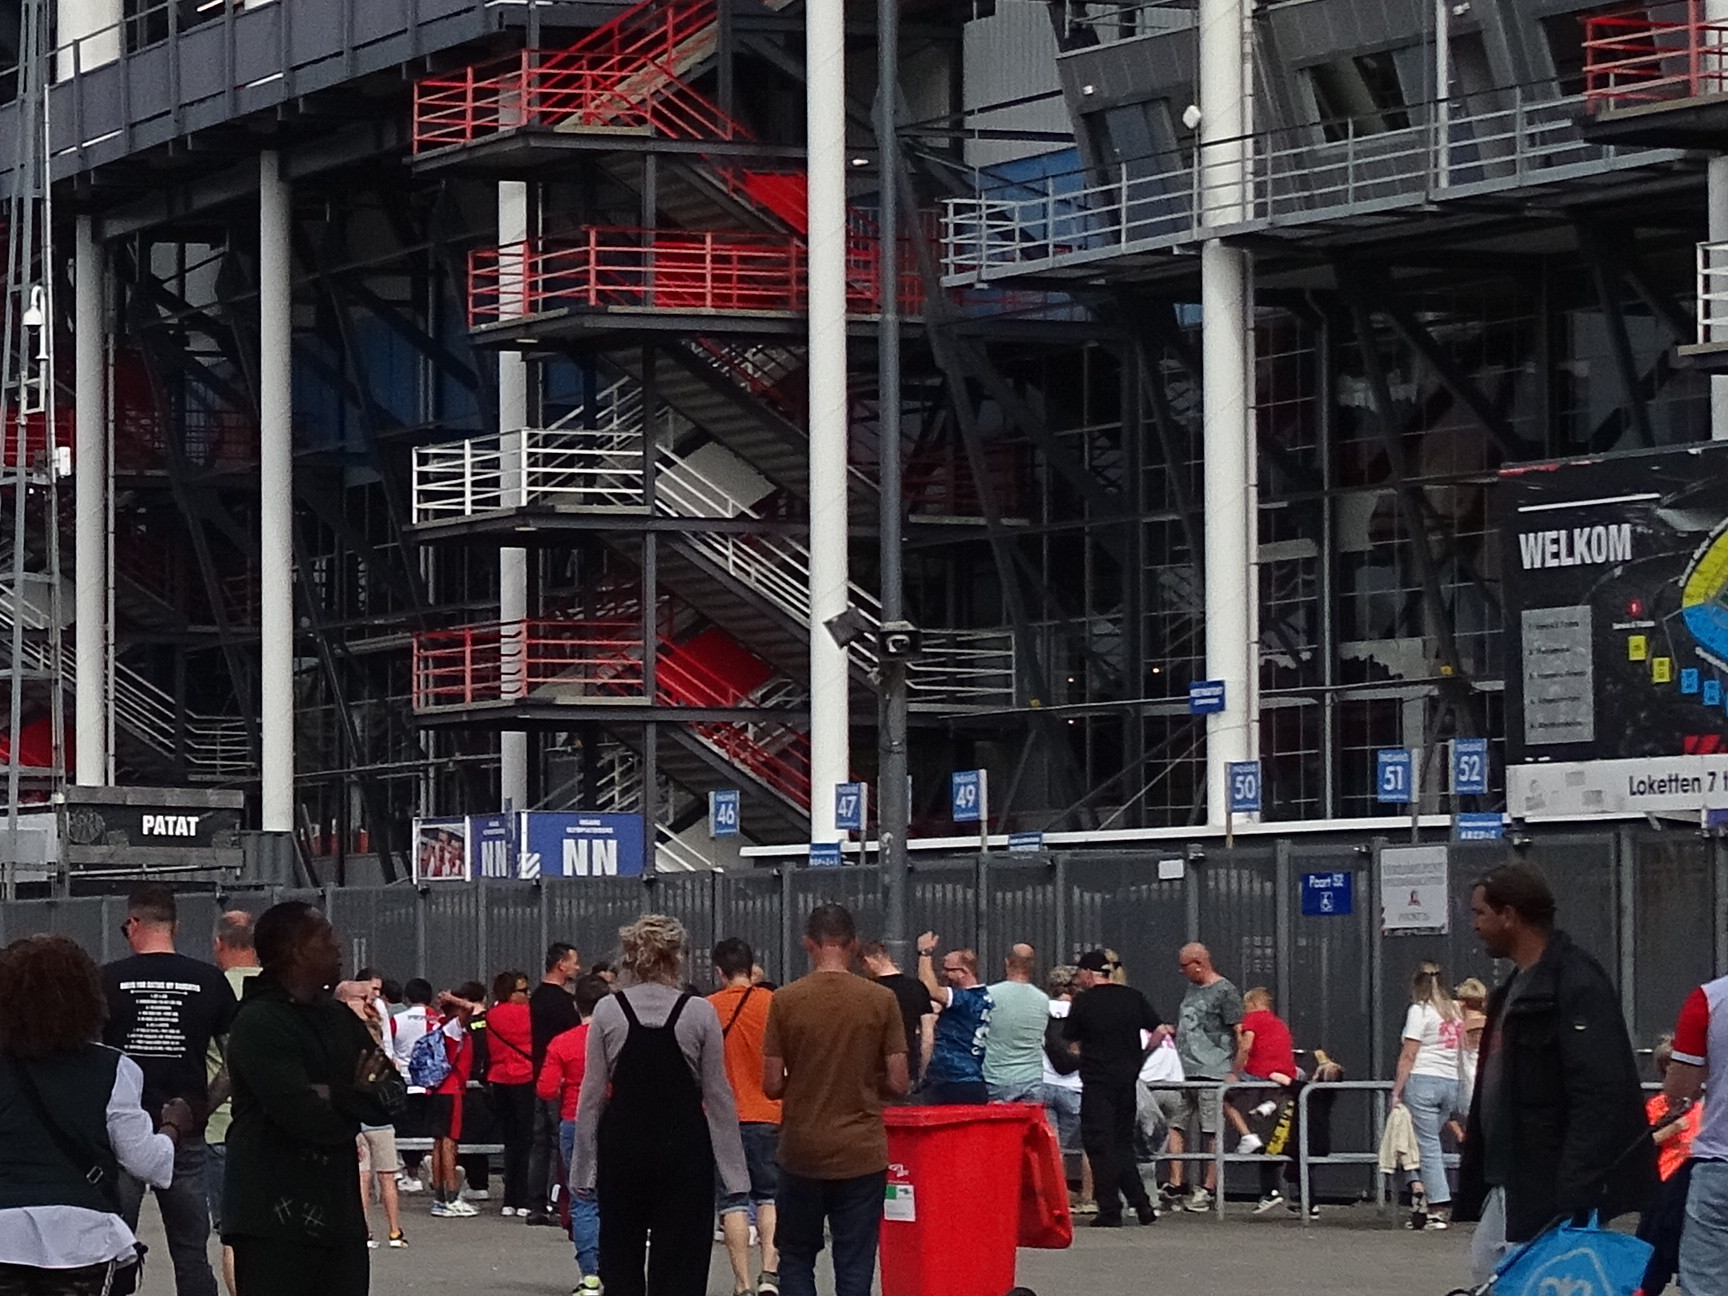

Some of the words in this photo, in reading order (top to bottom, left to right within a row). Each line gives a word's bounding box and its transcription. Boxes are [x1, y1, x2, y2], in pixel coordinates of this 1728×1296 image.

[1519, 524, 1632, 570] WELKOM
[1383, 765, 1404, 791] 51
[1458, 755, 1481, 782] 52
[1234, 774, 1257, 800] 50
[1629, 772, 1702, 796] Loketten
[1707, 771, 1717, 793] 7
[838, 795, 857, 818] 47
[956, 784, 976, 809] 49
[142, 815, 199, 836] PATAT
[717, 803, 735, 825] 46
[481, 840, 507, 878] NN
[563, 838, 617, 876] NN
[1309, 874, 1331, 888] Poort
